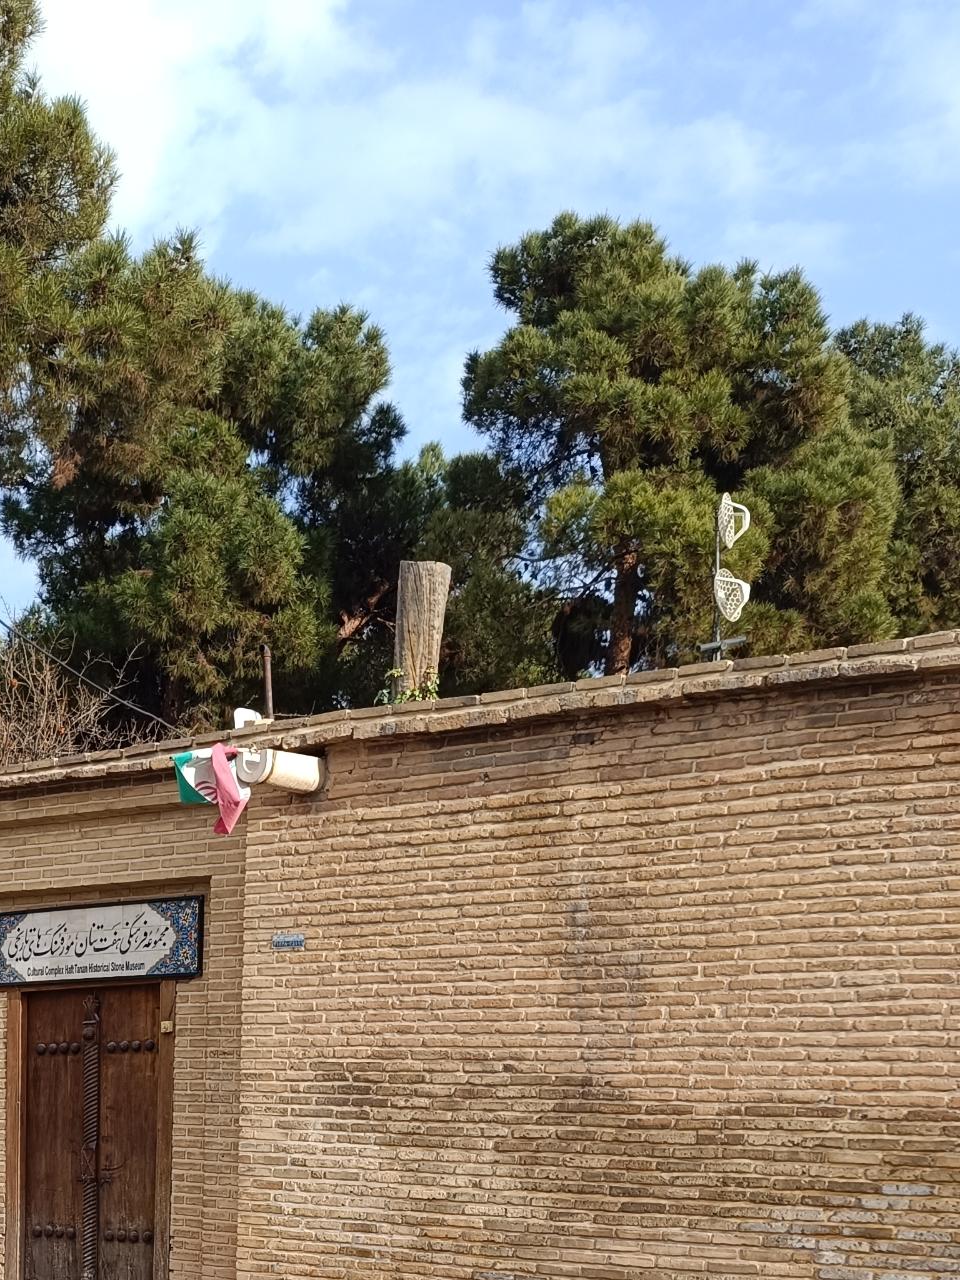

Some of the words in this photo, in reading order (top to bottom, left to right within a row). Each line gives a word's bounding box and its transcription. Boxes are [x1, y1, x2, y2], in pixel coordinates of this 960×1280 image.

[27, 967, 45, 977] Cultural
[45, 965, 64, 977] Complex
[89, 962, 110, 973] Historical
[111, 962, 125, 972] Stone
[125, 961, 145, 971] Museum
